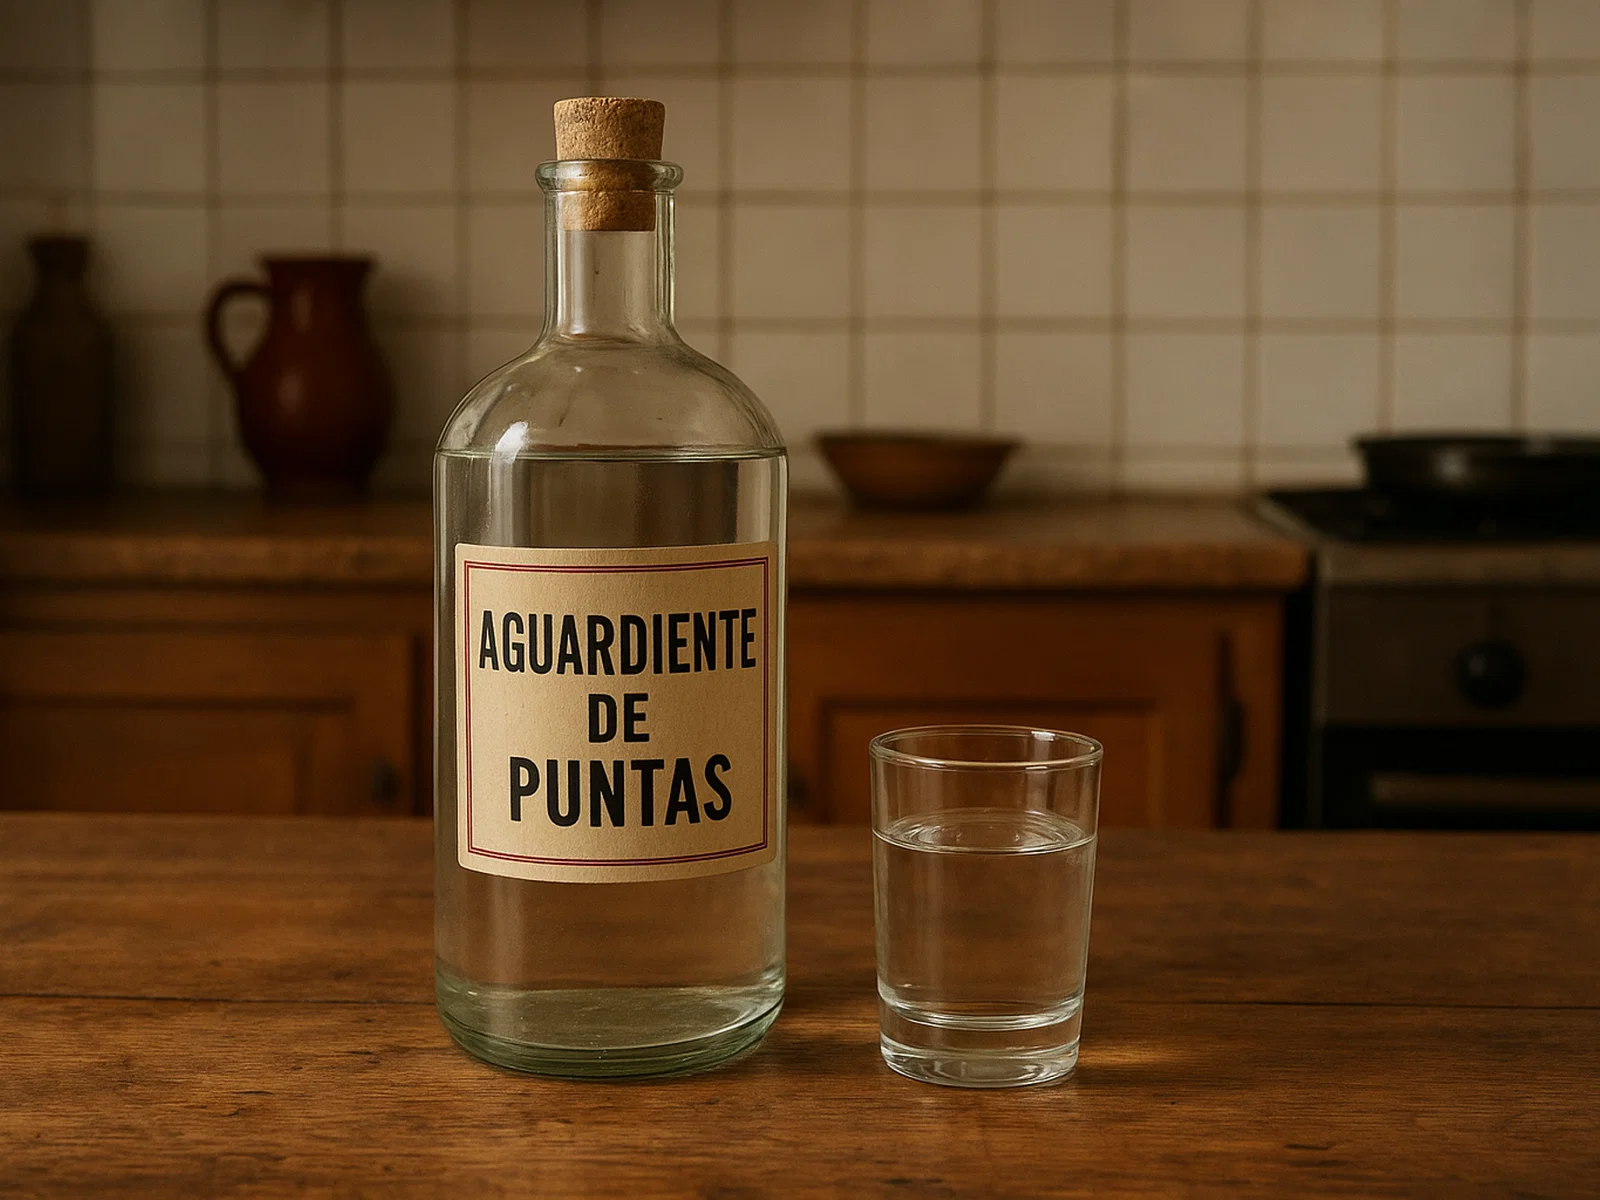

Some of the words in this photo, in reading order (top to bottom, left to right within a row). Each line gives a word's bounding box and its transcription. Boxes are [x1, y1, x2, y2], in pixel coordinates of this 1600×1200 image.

[479, 608, 757, 676] AGUARDIENTE
[588, 693, 650, 743] DE
[509, 754, 732, 827] PUNTAS
